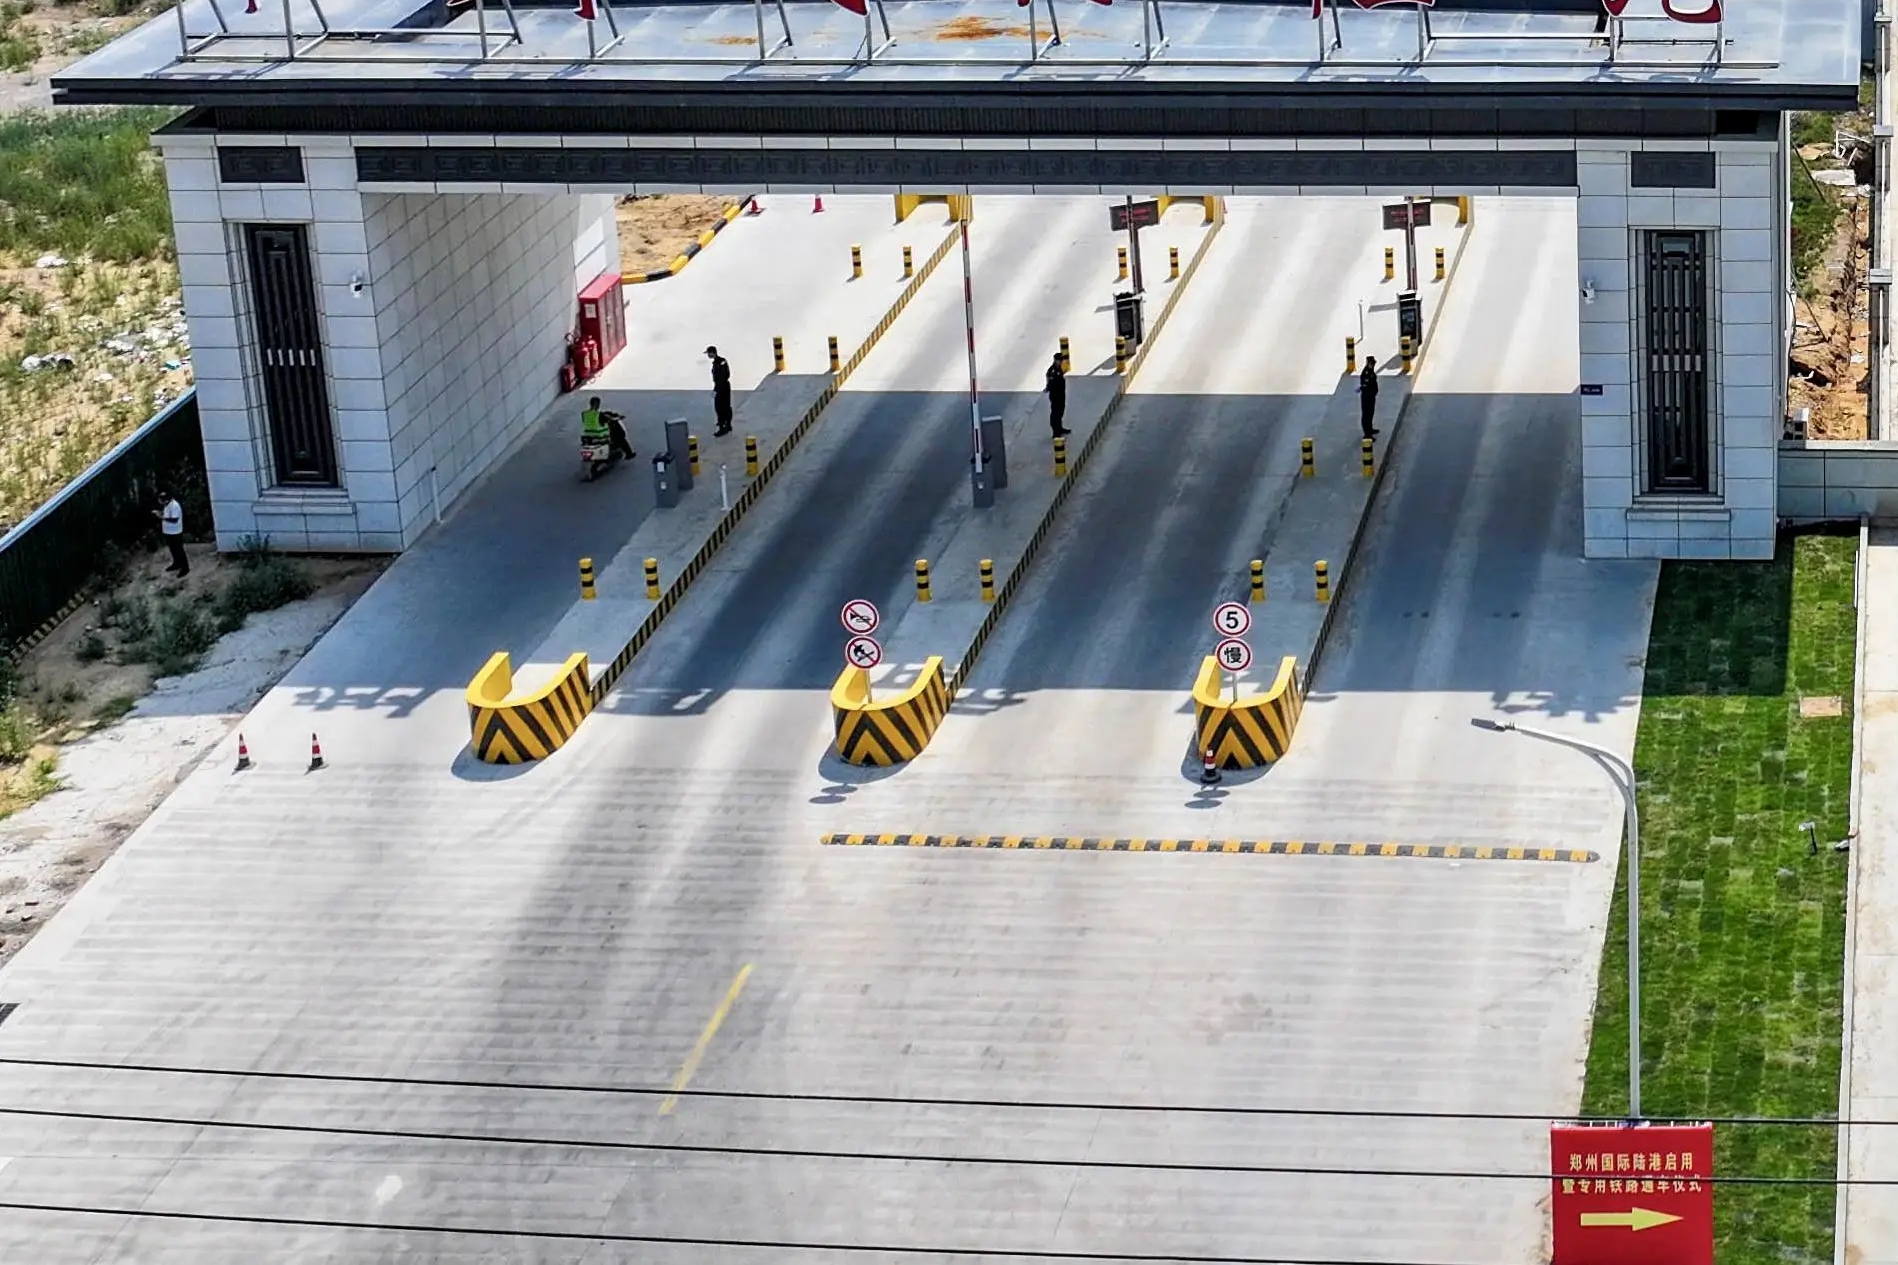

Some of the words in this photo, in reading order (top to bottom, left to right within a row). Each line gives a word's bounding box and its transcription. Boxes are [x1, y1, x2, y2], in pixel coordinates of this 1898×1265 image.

[1226, 611, 1239, 629] 5
[1224, 647, 1242, 663] 慢
[1569, 1152, 1694, 1172] 郑州国际陆港启用
